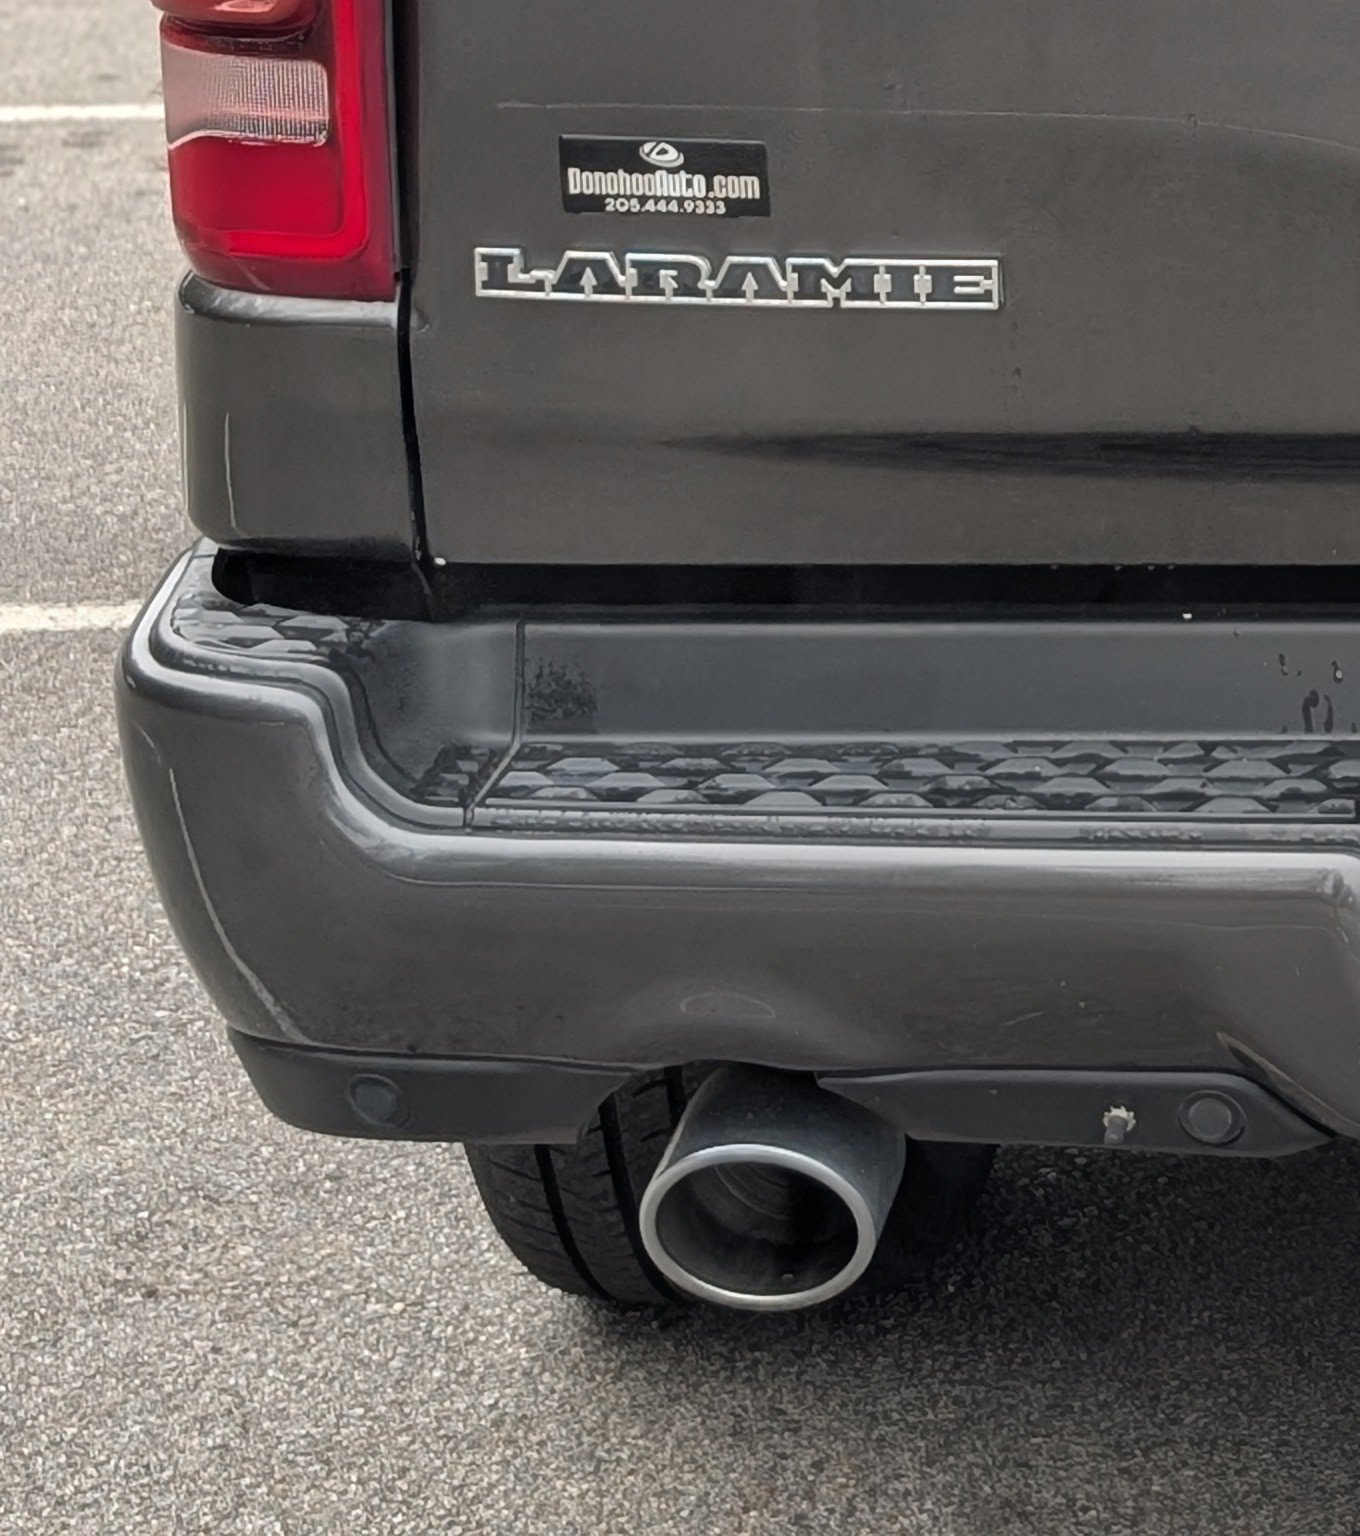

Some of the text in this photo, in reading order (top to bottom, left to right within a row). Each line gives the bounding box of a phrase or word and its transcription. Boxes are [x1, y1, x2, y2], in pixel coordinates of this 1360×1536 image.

[567, 167, 761, 199] DonohooAuto.com
[604, 198, 726, 215] 205.444.9333
[474, 247, 1002, 310] LARAMIE
